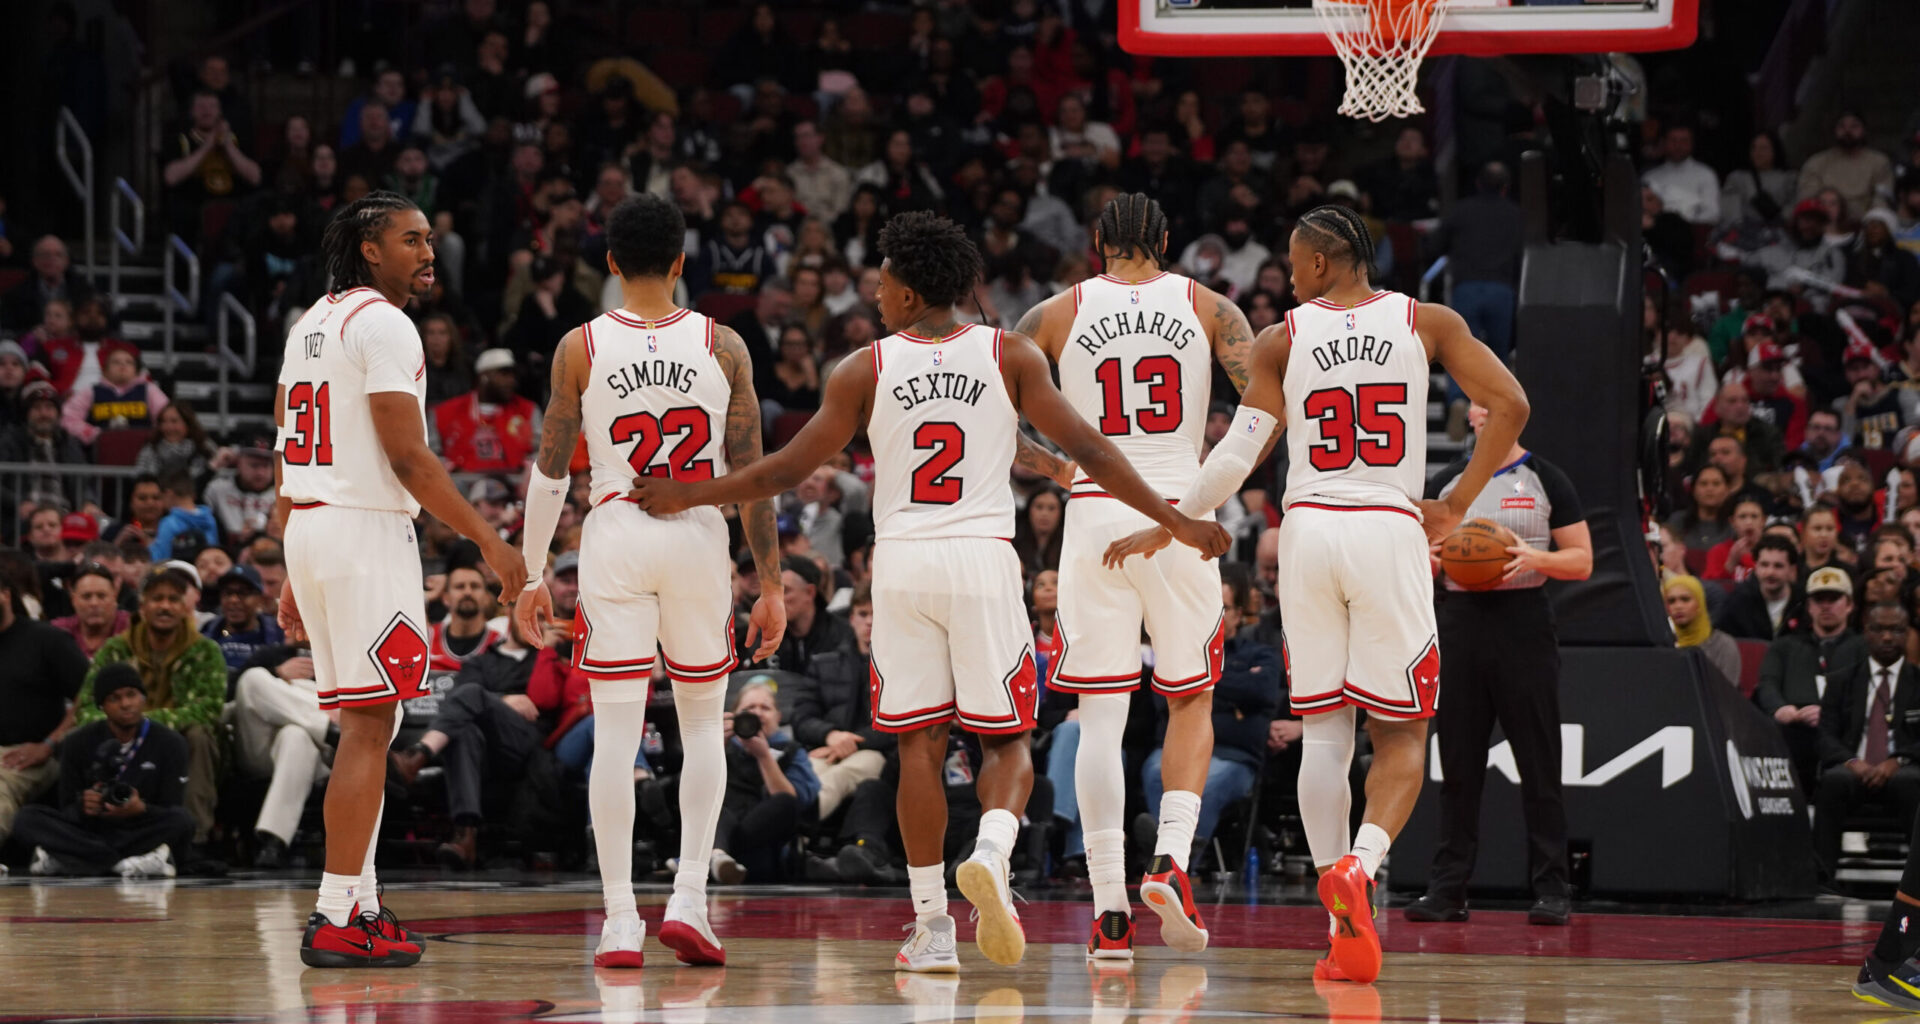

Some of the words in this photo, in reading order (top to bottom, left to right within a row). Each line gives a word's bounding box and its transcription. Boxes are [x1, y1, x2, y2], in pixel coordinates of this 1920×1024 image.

[305, 332, 325, 360] IVEY
[1076, 311, 1195, 356] RICHARDS
[1312, 335, 1393, 372] OKORO
[607, 360, 698, 399] SIMONS
[892, 372, 987, 411] SEXTON
[1095, 354, 1183, 436] 13
[283, 381, 333, 466] 31
[608, 406, 715, 484] 22
[1303, 382, 1407, 472] 35
[910, 421, 965, 506] 2
[1502, 499, 1534, 508] Emirates
